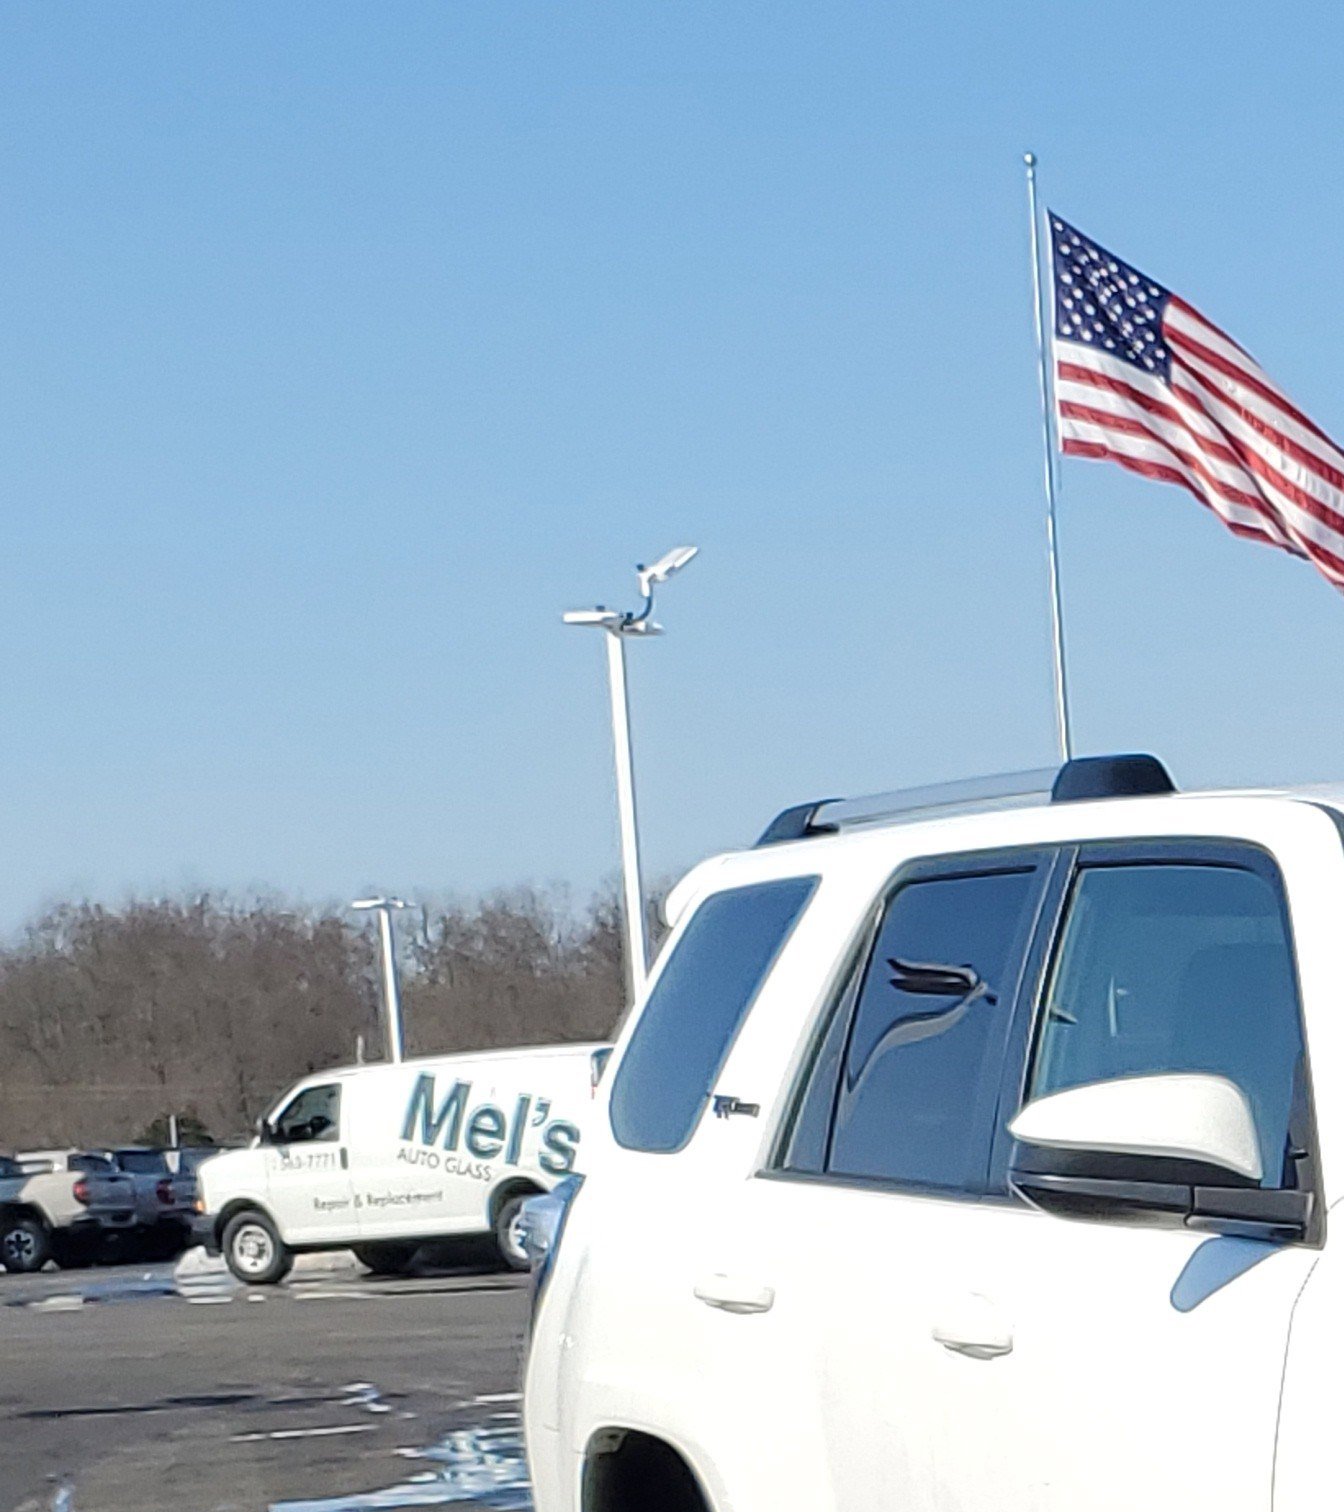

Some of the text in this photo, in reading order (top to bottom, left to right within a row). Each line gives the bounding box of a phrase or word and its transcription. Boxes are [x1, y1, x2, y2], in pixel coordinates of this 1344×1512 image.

[399, 1070, 582, 1178] Mel's
[397, 1148, 492, 1182] AUTO GLASS
